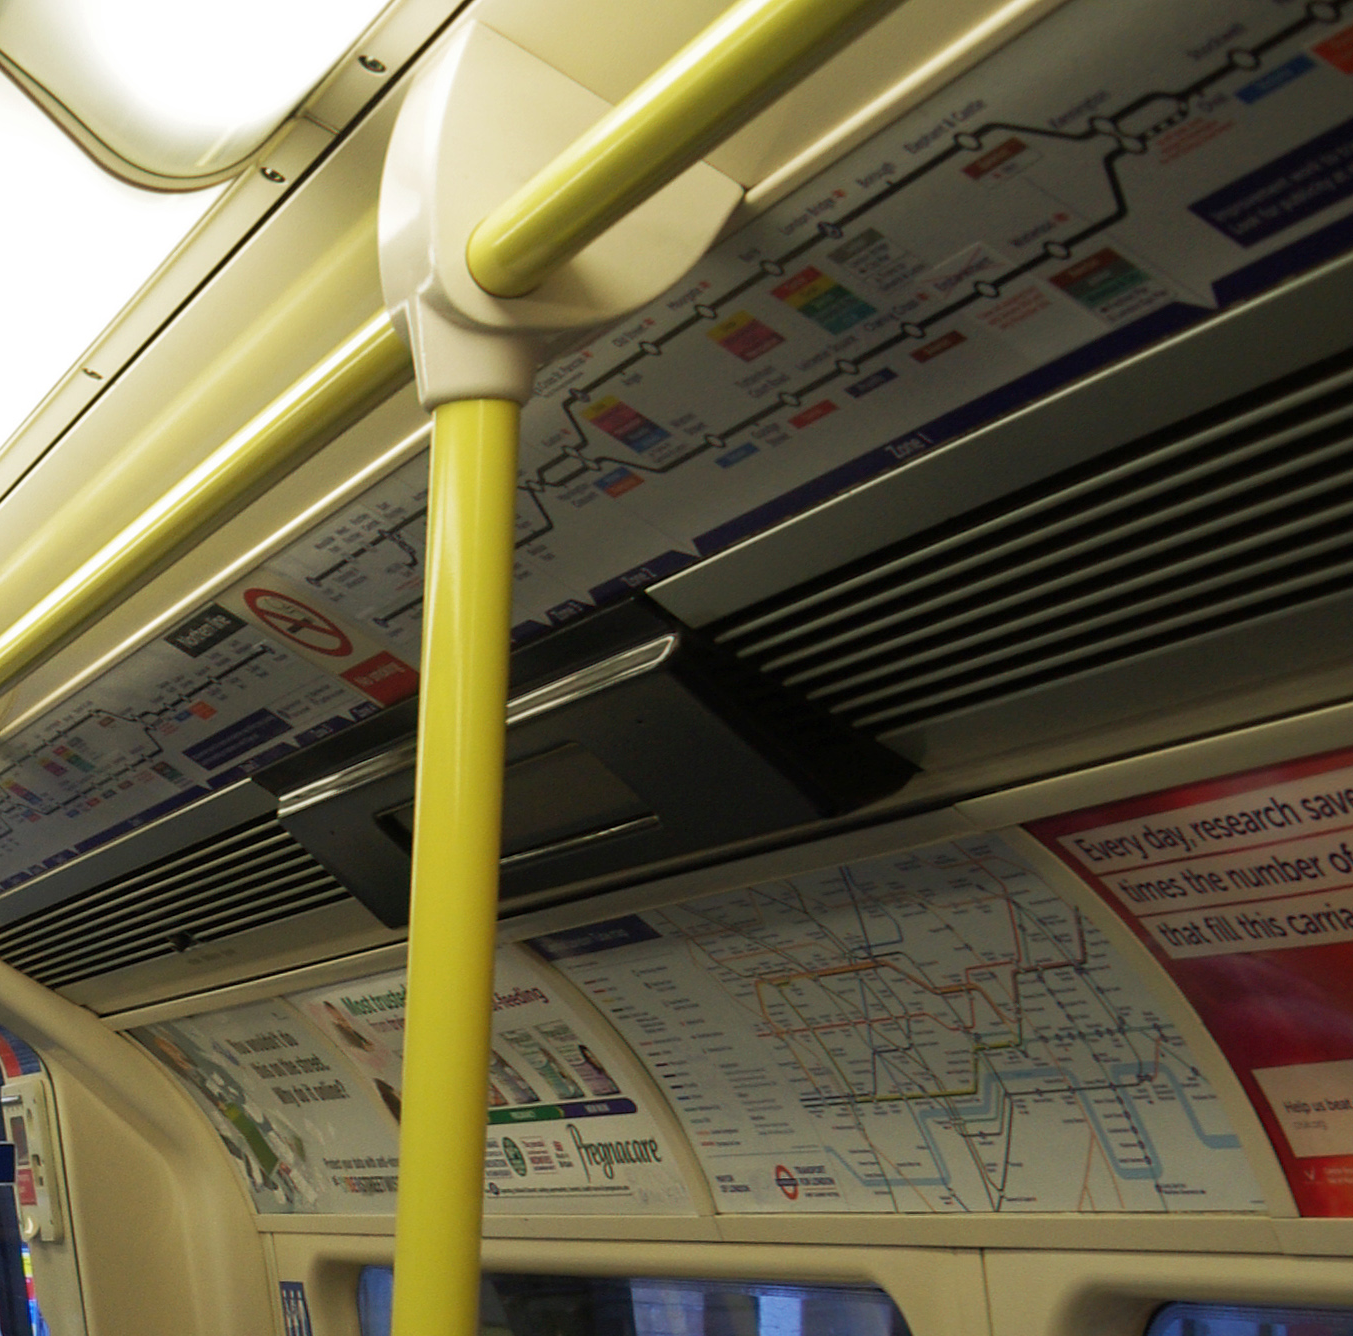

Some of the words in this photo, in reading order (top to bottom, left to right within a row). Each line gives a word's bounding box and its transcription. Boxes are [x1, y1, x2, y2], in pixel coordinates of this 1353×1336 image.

[885, 437, 924, 460] Zone
[176, 620, 213, 648] Northern
[210, 612, 232, 630] line
[1073, 837, 1149, 862] Every
[1142, 823, 1197, 853] day,
[1190, 797, 1303, 843] research
[1118, 878, 1188, 904] times
[1182, 867, 1230, 895] the
[1227, 854, 1327, 890] number
[1156, 922, 1211, 948] that
[1202, 913, 1244, 944] fill
[1235, 911, 1288, 939] this
[341, 991, 375, 1016] Most
[1283, 1100, 1311, 1114] Help
[566, 1123, 662, 1183] Pregnacare
